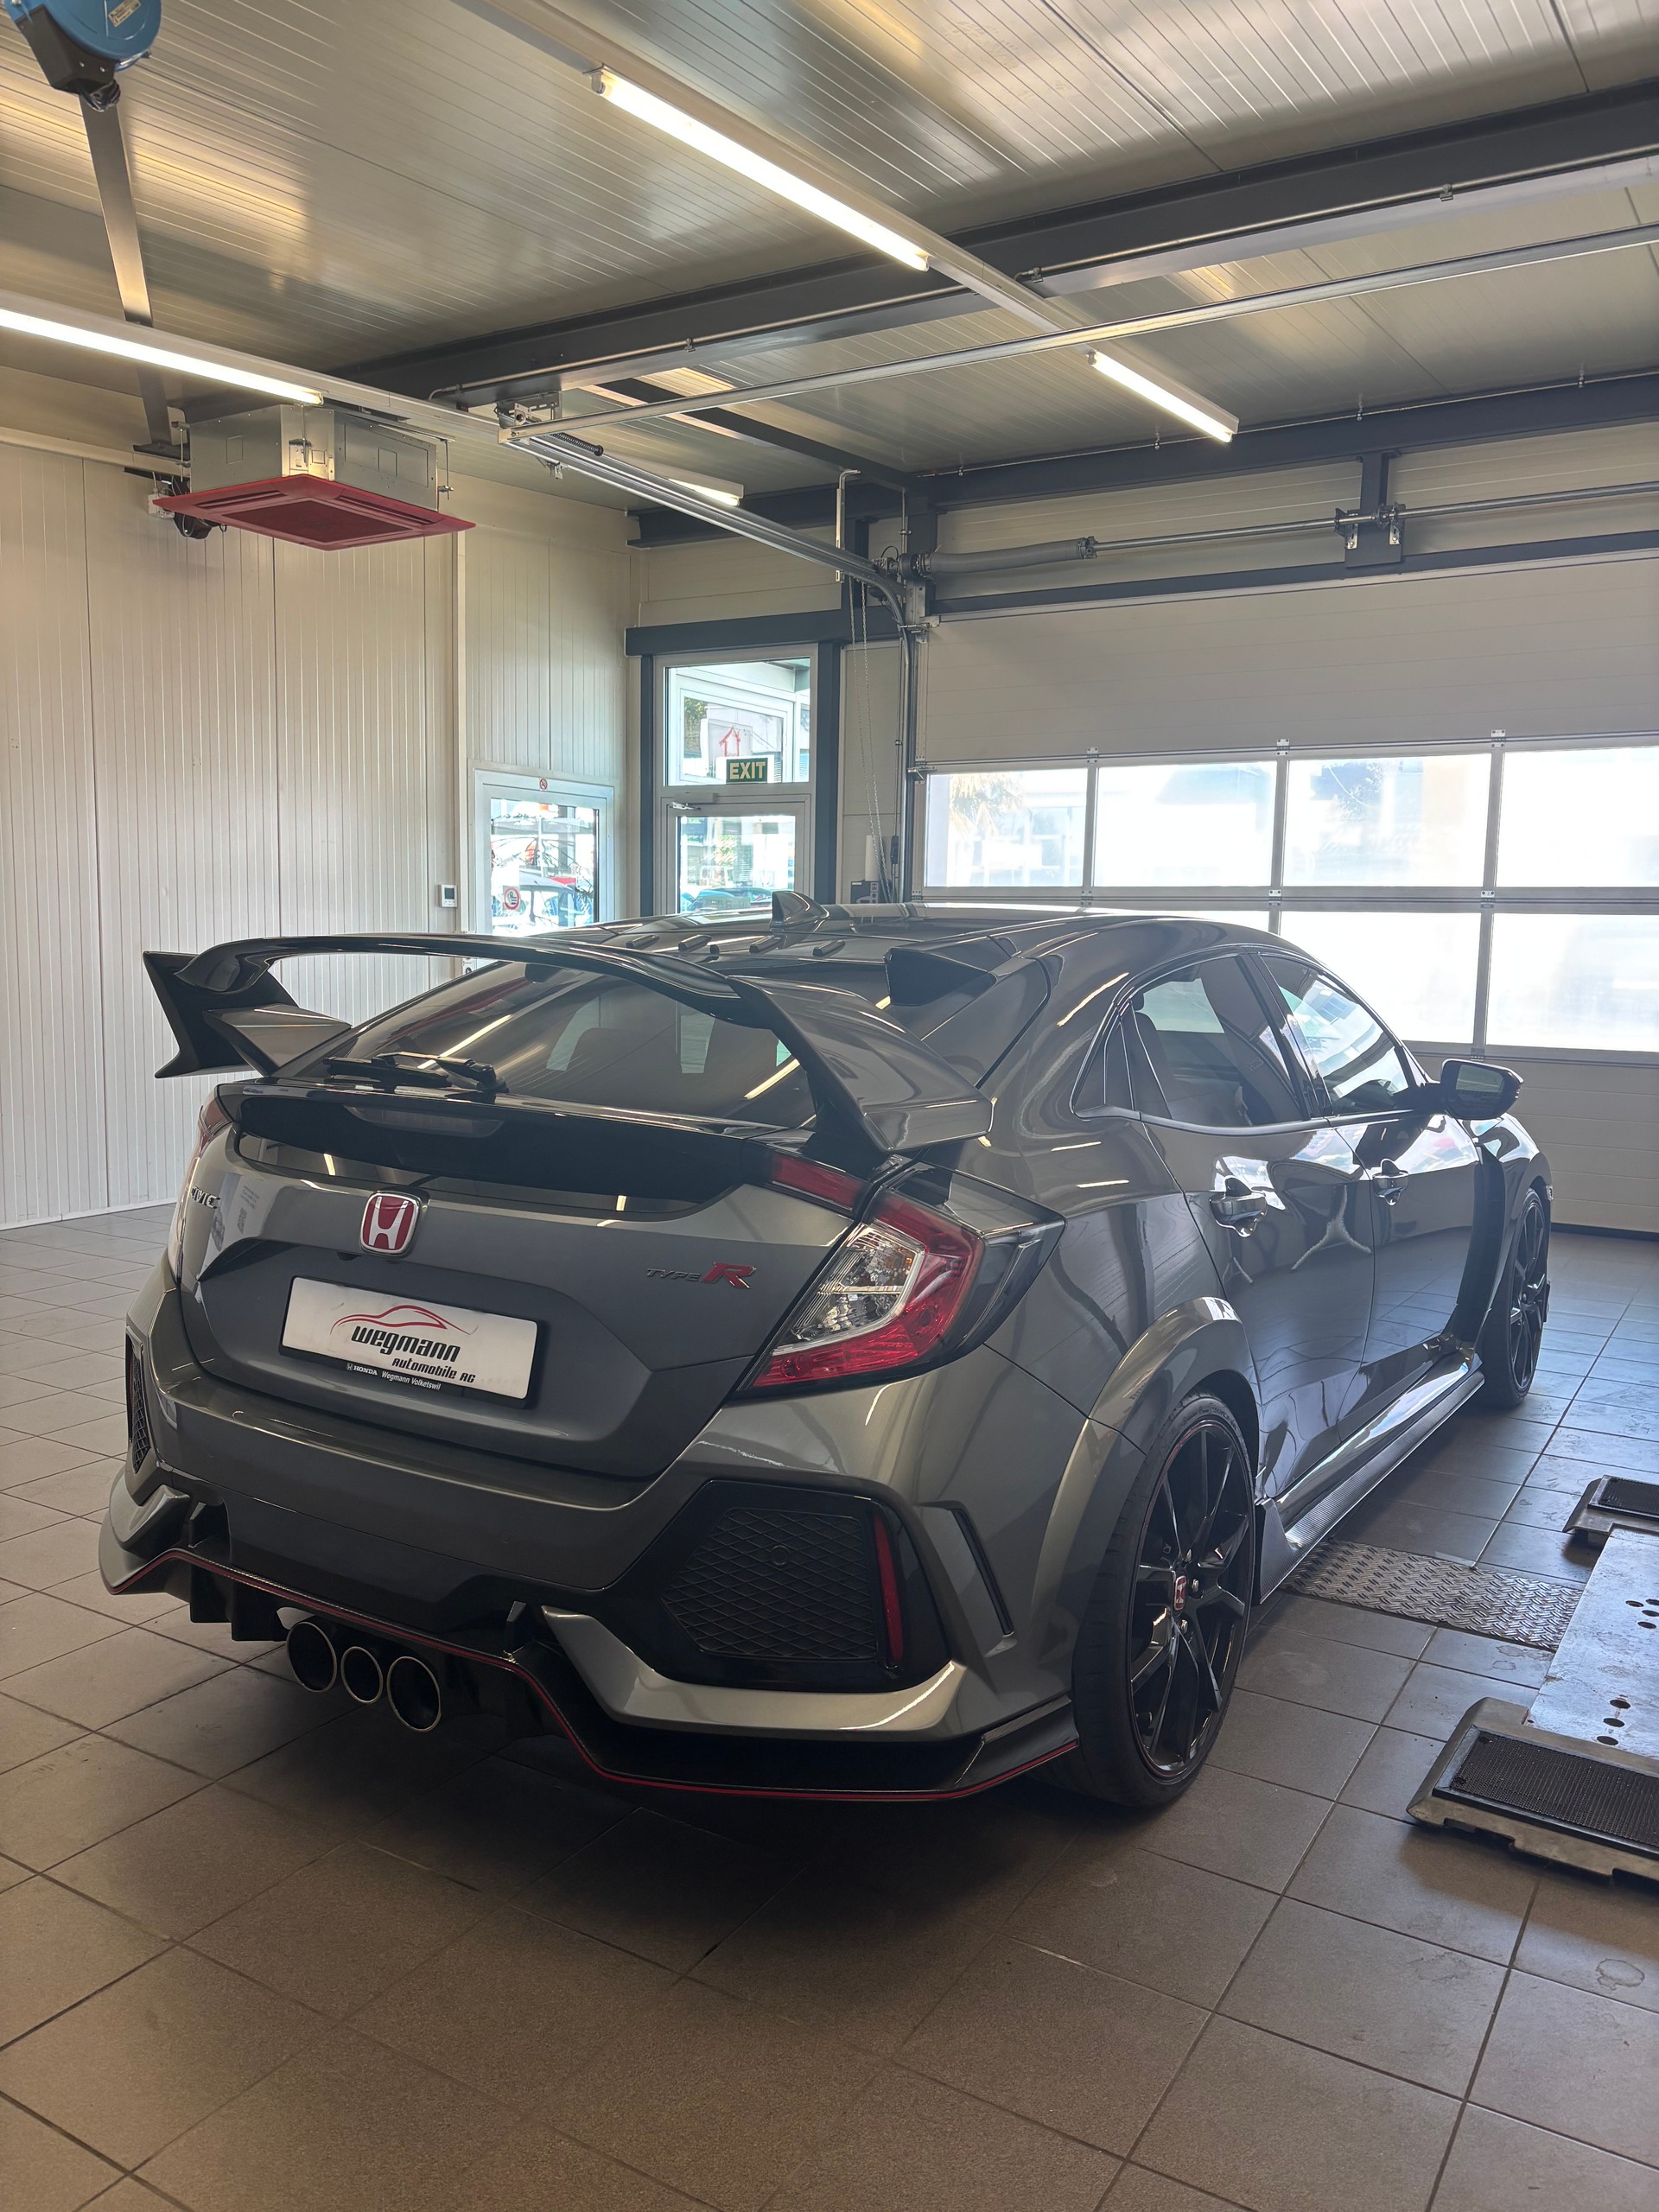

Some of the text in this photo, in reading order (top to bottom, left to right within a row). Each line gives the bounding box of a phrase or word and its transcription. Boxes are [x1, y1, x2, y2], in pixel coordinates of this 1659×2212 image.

[729, 761, 766, 779] EXIT
[646, 1262, 757, 1289] TYPE R
[351, 1325, 461, 1363] wegmann
[353, 1365, 378, 1376] HONDA
[381, 1370, 410, 1383] Wegmann
[411, 1377, 442, 1390] Volketswil
[459, 1372, 476, 1383] AG
